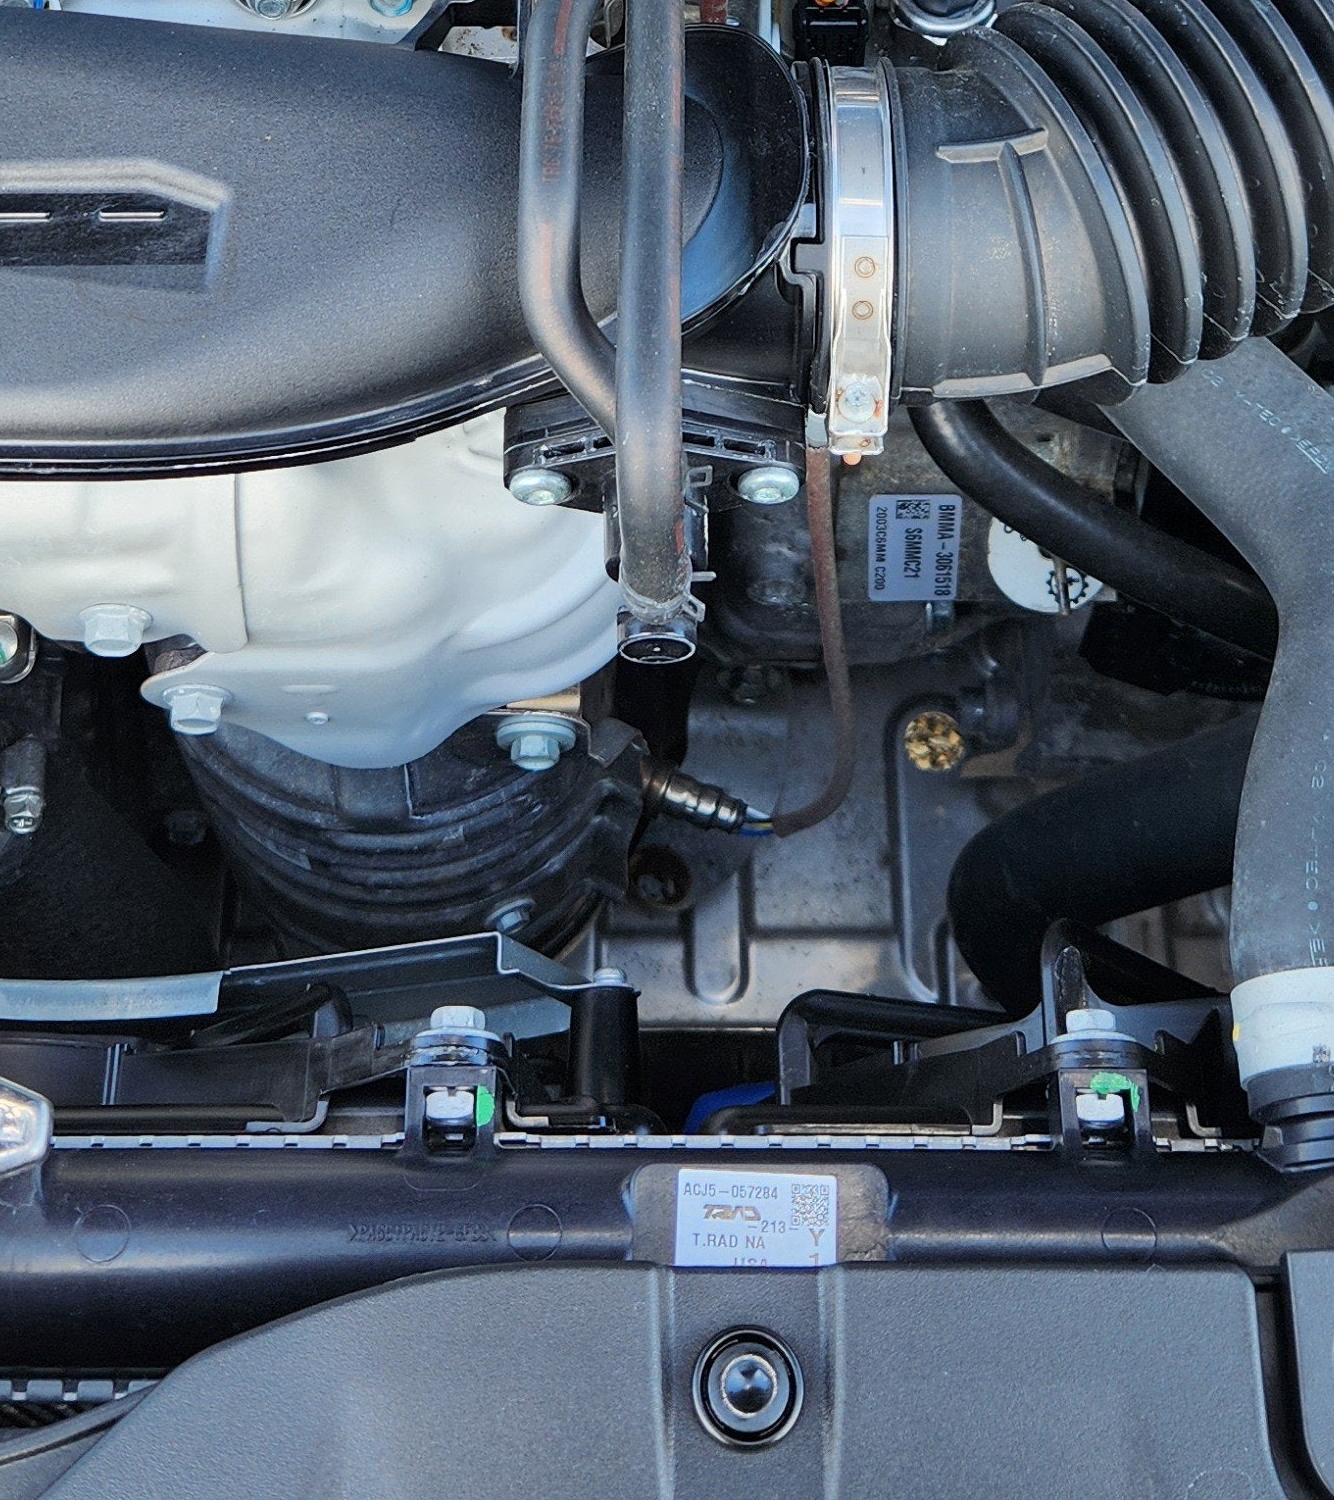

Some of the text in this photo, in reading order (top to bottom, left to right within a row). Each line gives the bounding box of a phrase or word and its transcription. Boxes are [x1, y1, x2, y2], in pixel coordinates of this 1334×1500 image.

[904, 527, 923, 578] S6MMC21
[874, 566, 886, 590] C200
[693, 1228, 825, 1249] T.RAD NA Y
